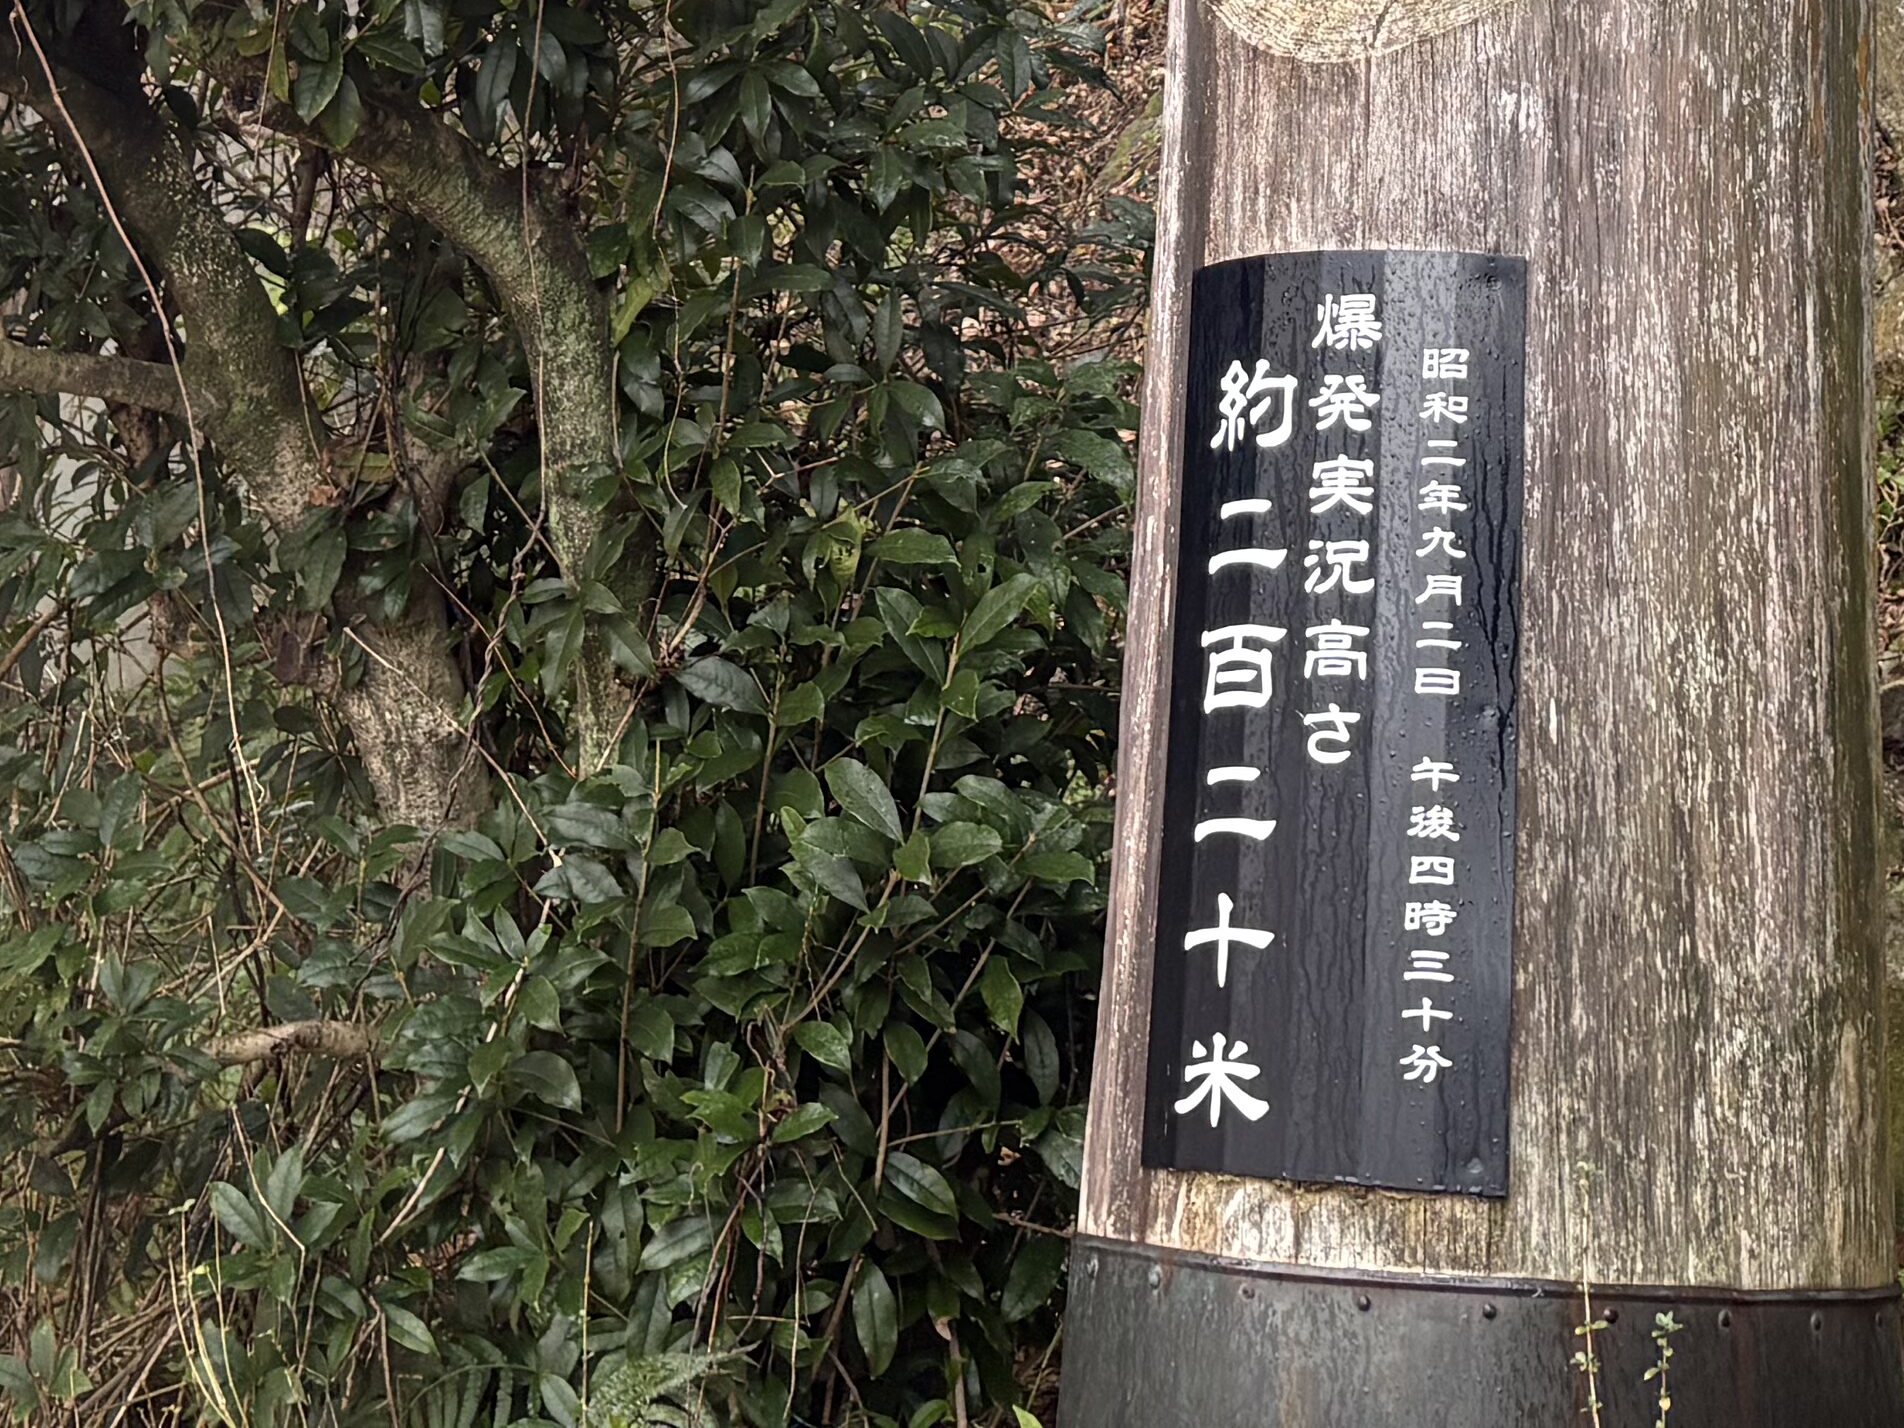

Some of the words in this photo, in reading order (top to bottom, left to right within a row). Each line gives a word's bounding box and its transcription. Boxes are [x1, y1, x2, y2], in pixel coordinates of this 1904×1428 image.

[1302, 292, 1383, 765] 爆発実況高さ
[1412, 346, 1470, 696] 昭和二年九月二日
[1174, 358, 1298, 1129] 約二百二十米
[1398, 756, 1460, 1084] 午後四時三十分
